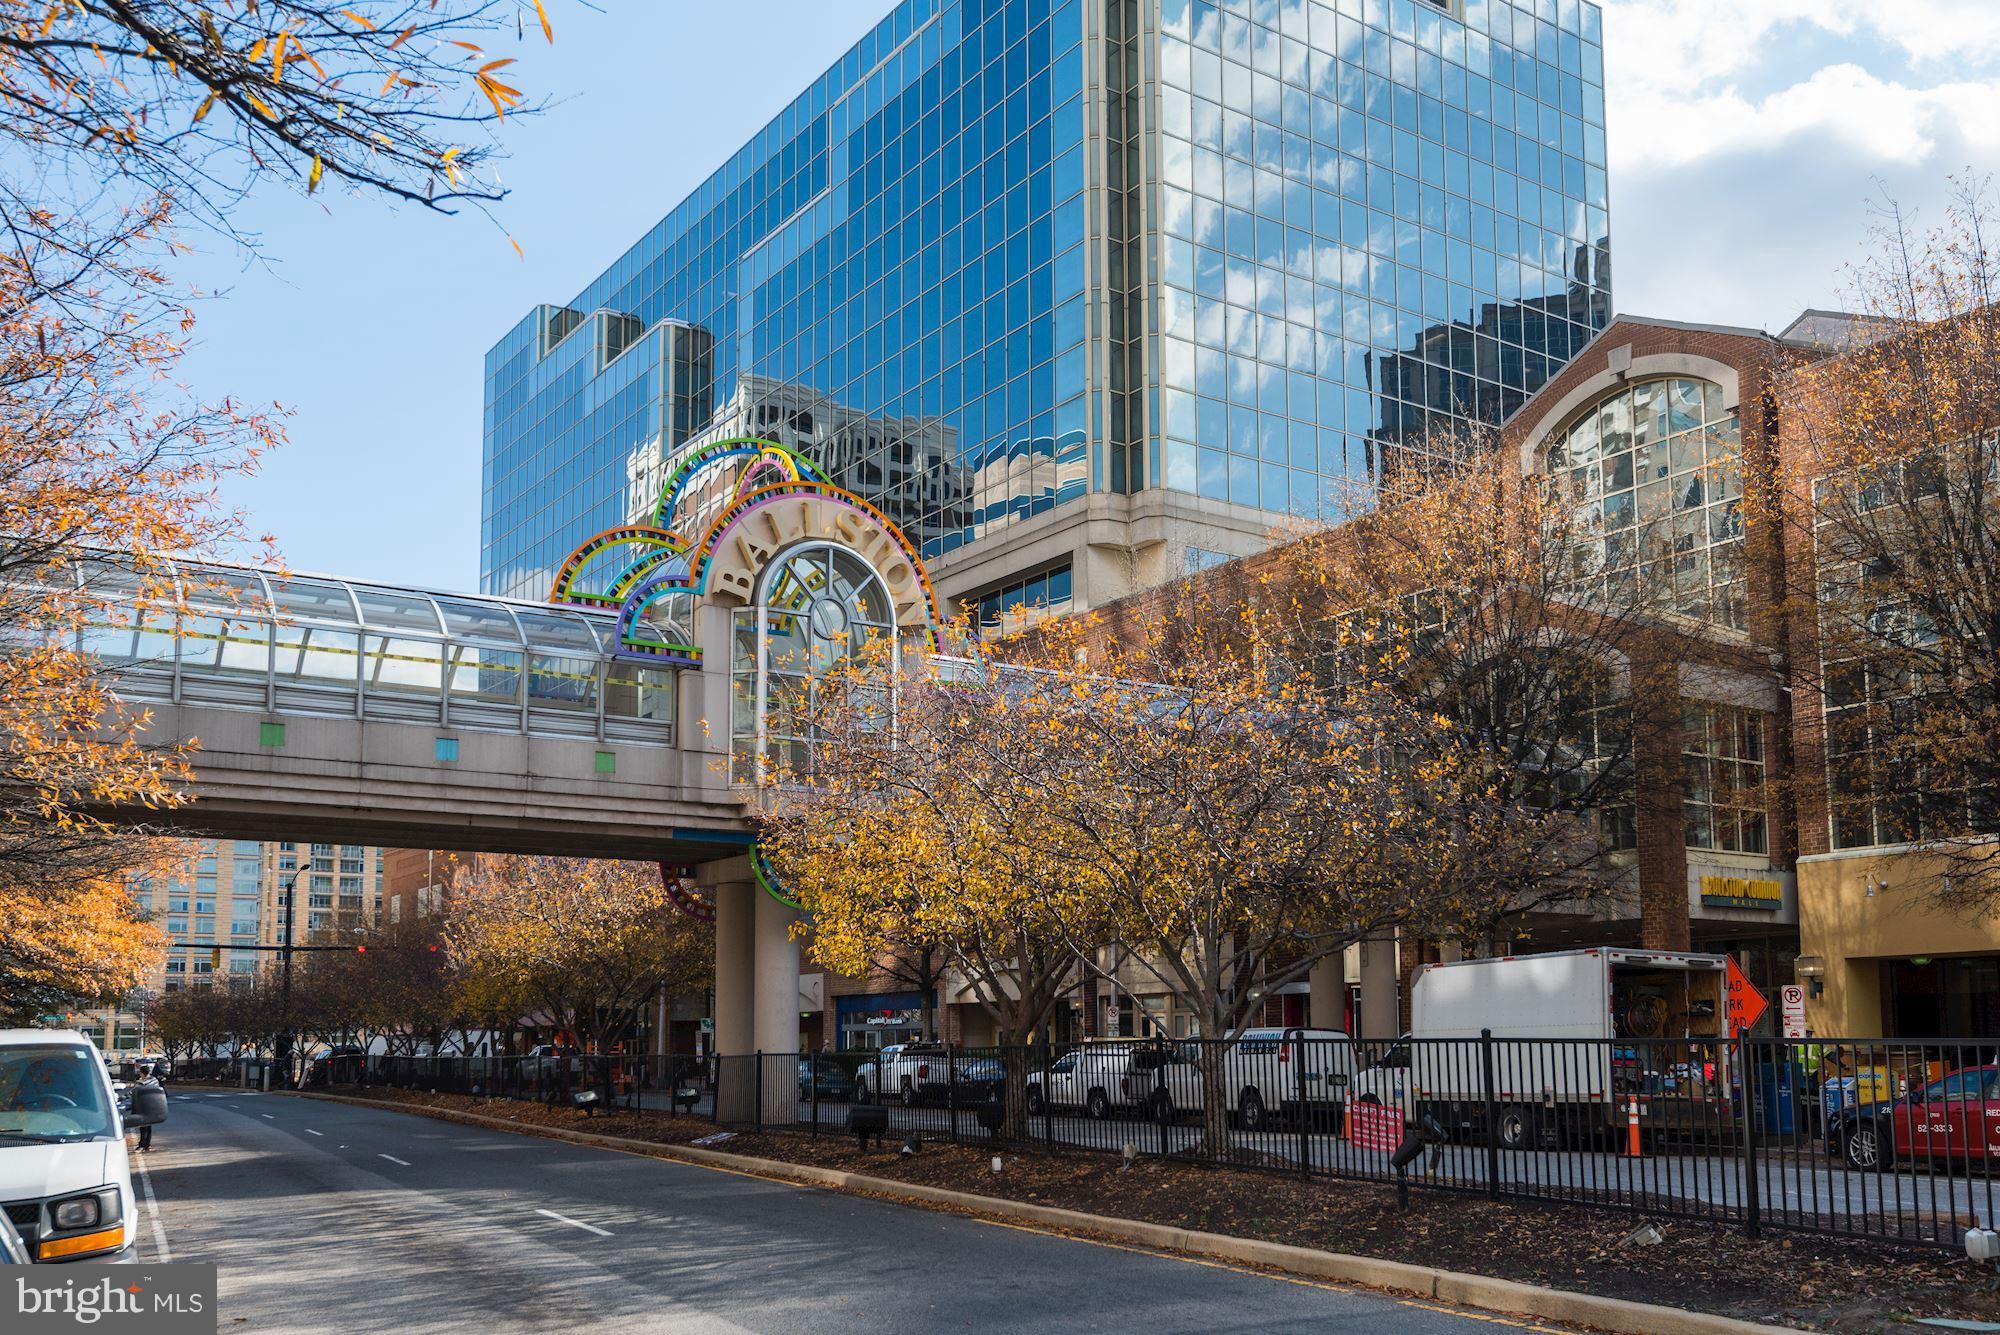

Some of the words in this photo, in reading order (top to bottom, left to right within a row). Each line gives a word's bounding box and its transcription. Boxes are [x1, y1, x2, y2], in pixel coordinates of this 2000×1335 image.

[713, 501, 929, 626] BALLSTON
[1728, 980, 1743, 992] AD
[1729, 998, 1744, 1011] RK
[1917, 1124, 1954, 1133] 52-3333
